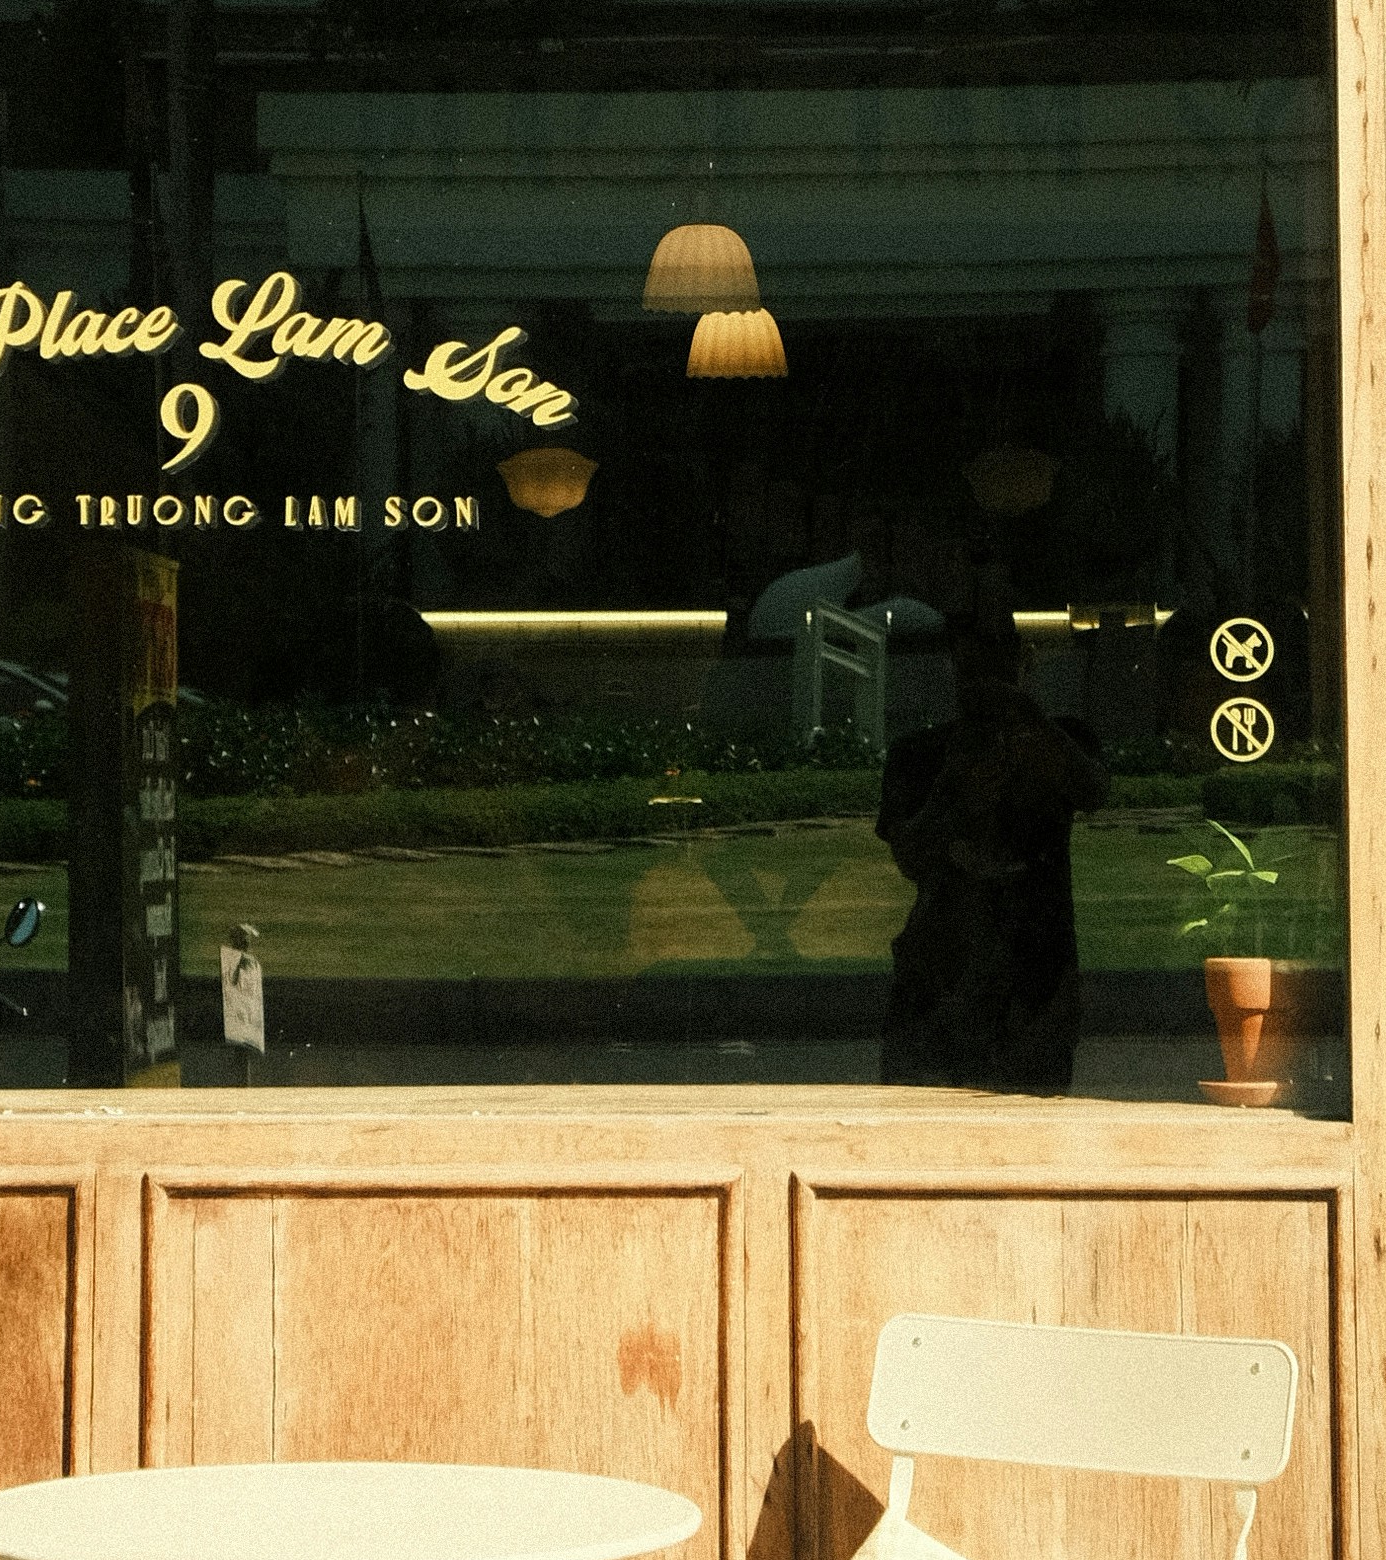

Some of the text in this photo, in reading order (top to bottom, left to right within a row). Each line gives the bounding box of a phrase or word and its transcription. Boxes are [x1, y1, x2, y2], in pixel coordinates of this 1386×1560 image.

[198, 271, 390, 381] Lam
[403, 326, 579, 428] Son
[159, 382, 217, 472] 9
[75, 493, 256, 527] TRUONG
[284, 494, 358, 528] LAM
[384, 495, 475, 529] SON
